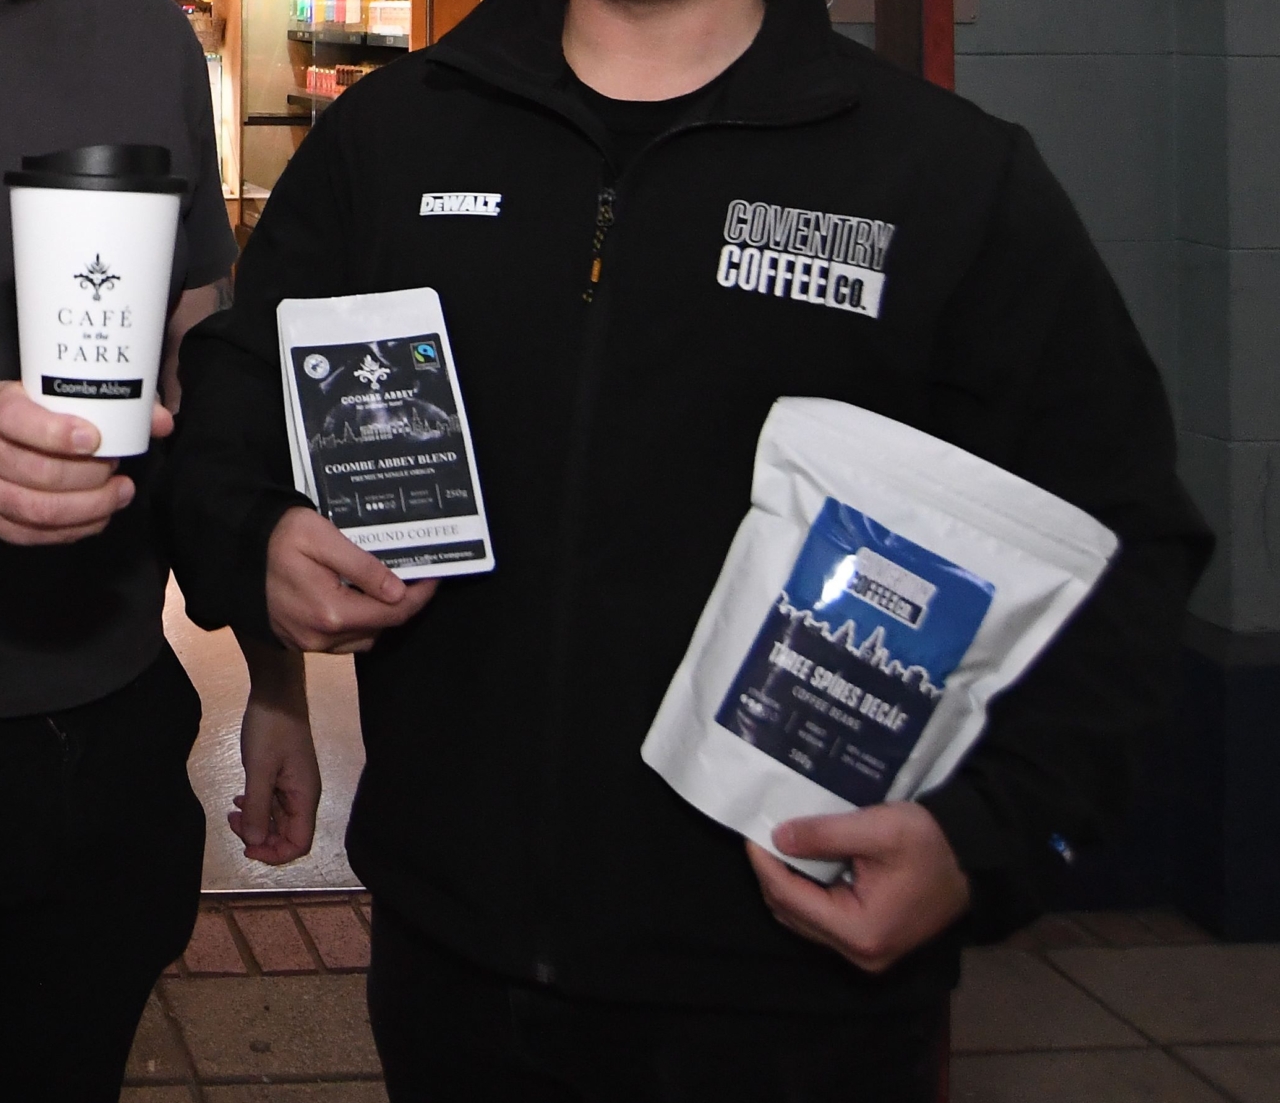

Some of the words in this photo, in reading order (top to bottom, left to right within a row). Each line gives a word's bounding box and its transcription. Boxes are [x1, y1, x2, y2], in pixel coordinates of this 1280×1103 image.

[723, 199, 896, 271] COVENTRY
[717, 244, 829, 304] COFFEE
[58, 306, 132, 328] CAFÉ
[95, 332, 109, 340] the
[57, 343, 130, 363] PARK
[53, 379, 97, 394] Coombe
[100, 382, 131, 397] Abbey
[325, 459, 375, 475] COOMBE
[377, 455, 416, 469] ABBEY
[418, 451, 457, 464] BLEND
[408, 524, 459, 539] COFFEE
[768, 641, 816, 681] THREE
[859, 693, 909, 731] DECAF
